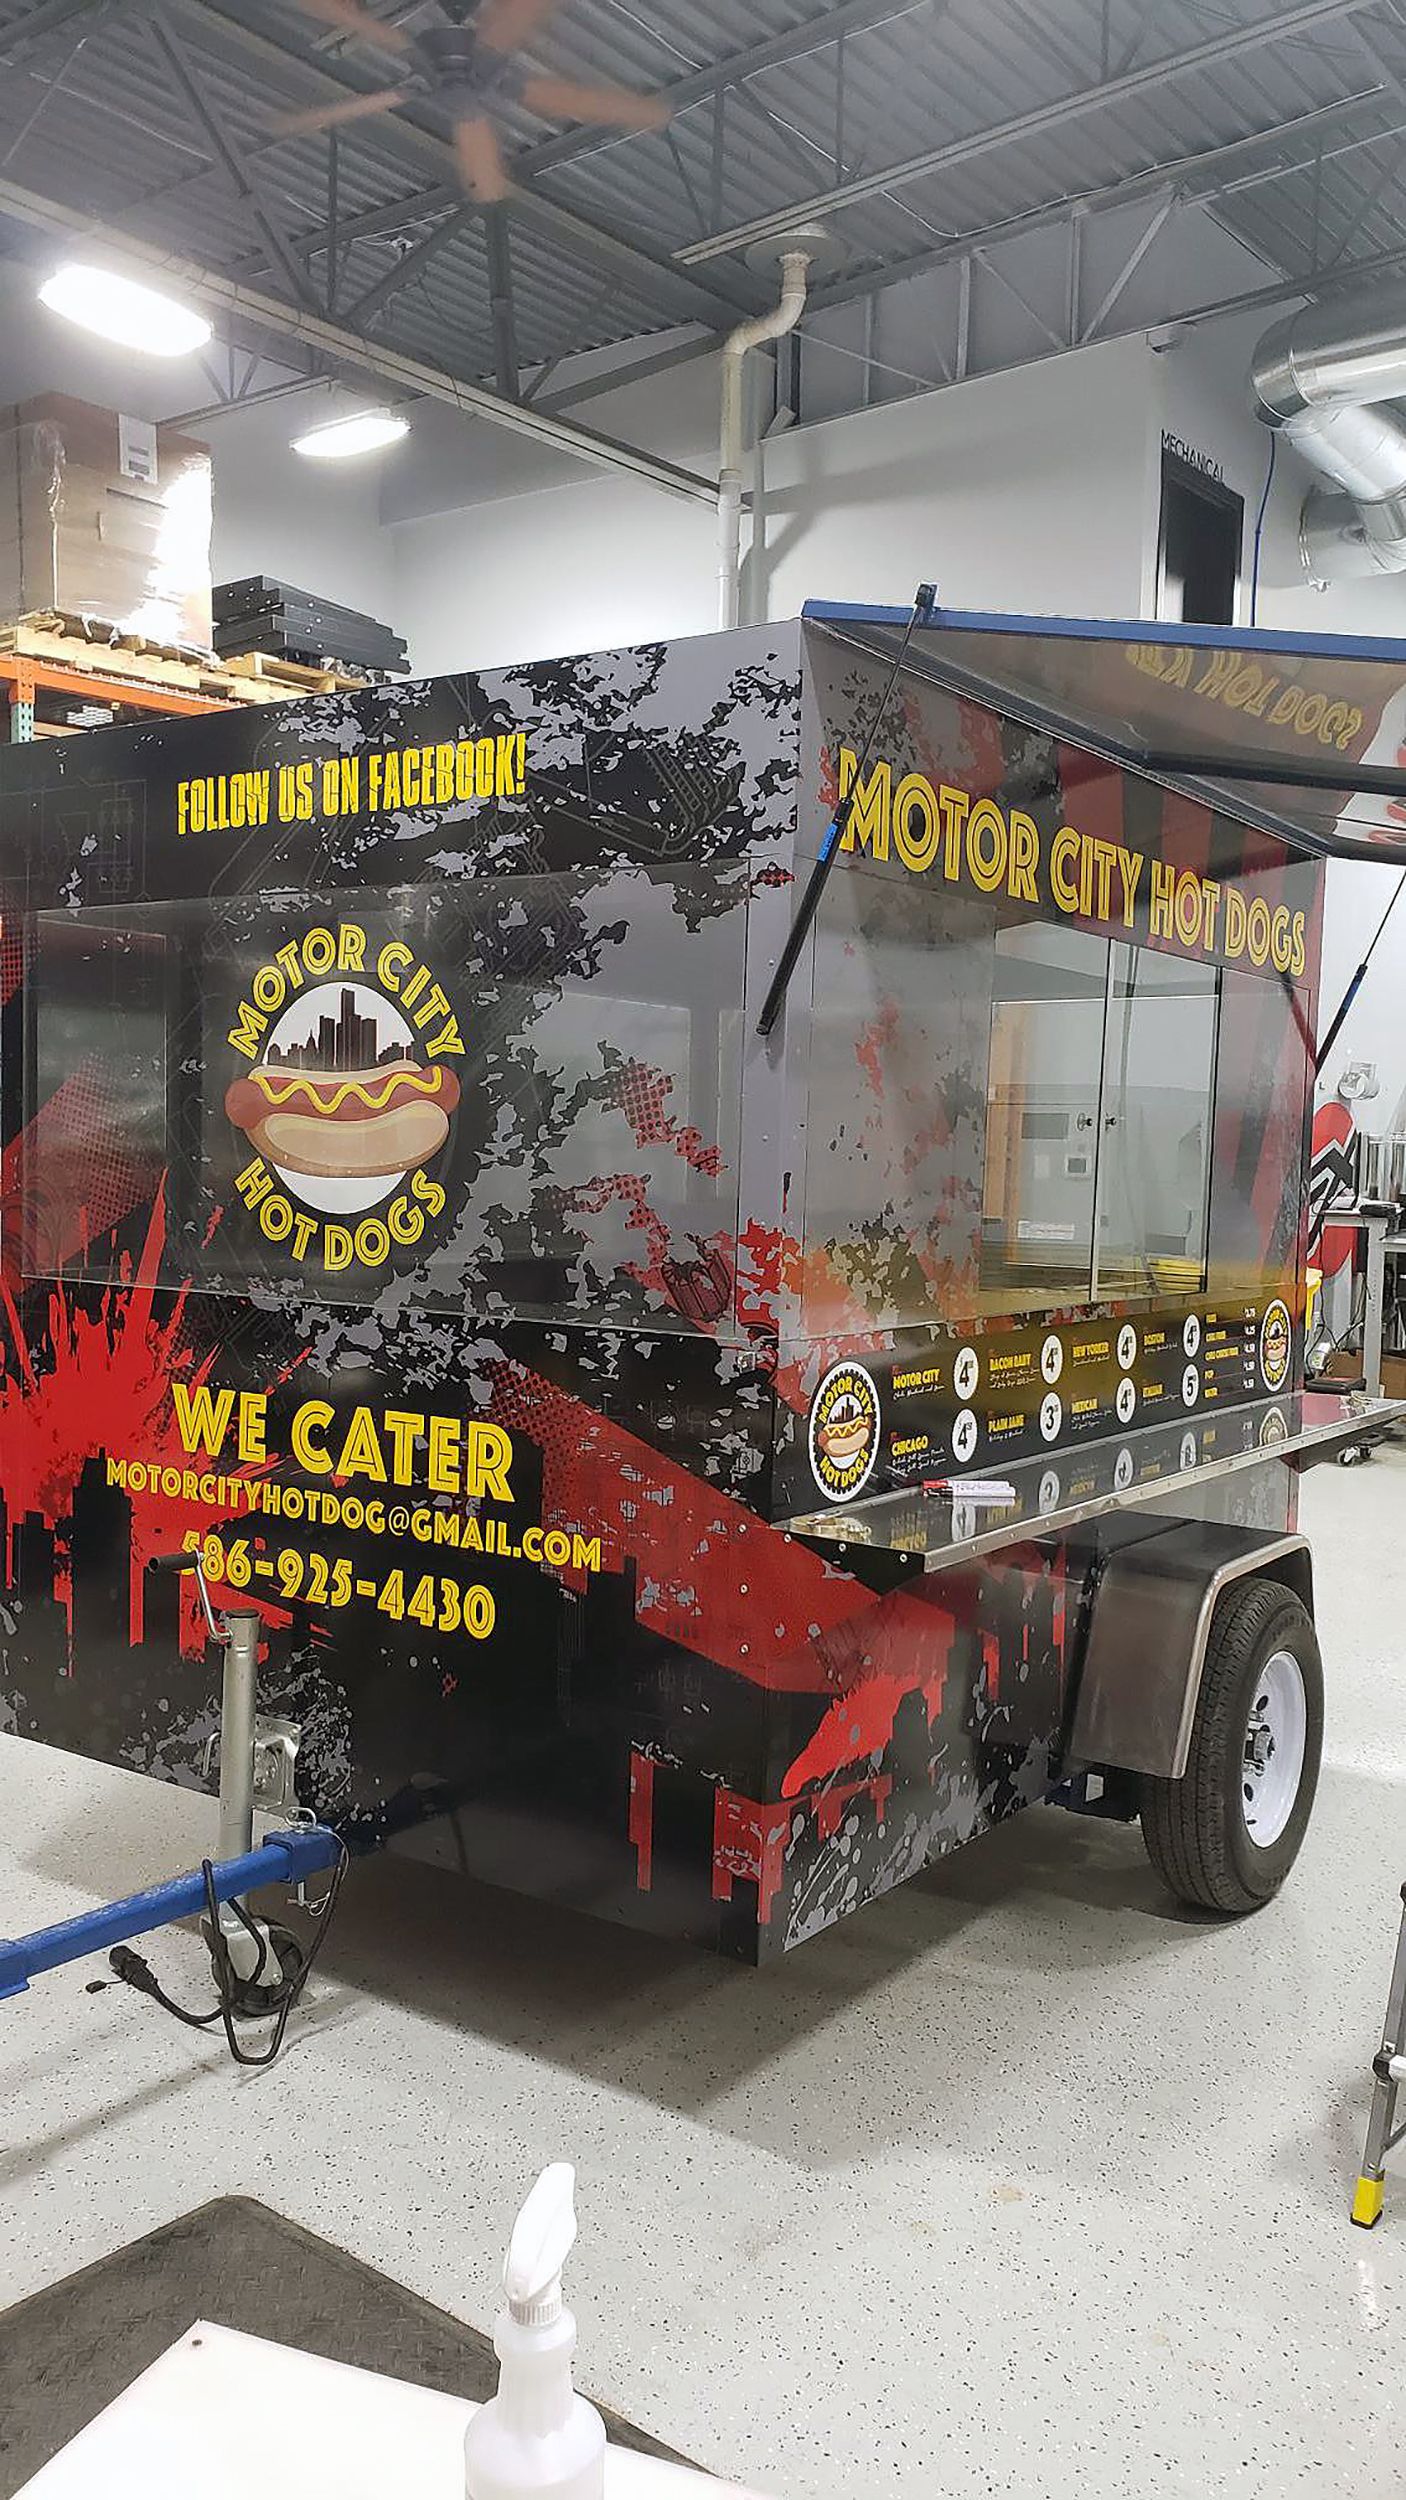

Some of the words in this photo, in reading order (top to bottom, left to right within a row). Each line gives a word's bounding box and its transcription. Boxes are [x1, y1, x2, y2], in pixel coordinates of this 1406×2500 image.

[178, 770, 270, 835] FOLLOW
[278, 763, 313, 823] US
[322, 756, 359, 817] ON
[368, 732, 526, 812] FACEBOOK!
[839, 747, 1040, 904] MOTOR
[1050, 825, 1144, 928] CITY
[1149, 859, 1220, 950] HOT
[1224, 886, 1306, 977] DOGS
[227, 924, 367, 1060] MOTOR
[377, 941, 466, 1059] CITY
[235, 1157, 317, 1261] HOT
[325, 1169, 446, 1271] DOGS
[818, 1376, 853, 1424] MOTOR
[853, 1379, 873, 1415] CITY
[892, 1371, 921, 1390] MOTOR
[922, 1368, 941, 1385] CITY
[172, 1383, 268, 1463] WE
[291, 1400, 515, 1503] CATER
[819, 1455, 840, 1486] HOT
[841, 1448, 869, 1488] DOGS
[892, 1435, 929, 1456] CHICAGO
[106, 1458, 601, 1571] MOTORCITYHOTDOG@GMAIL.COM
